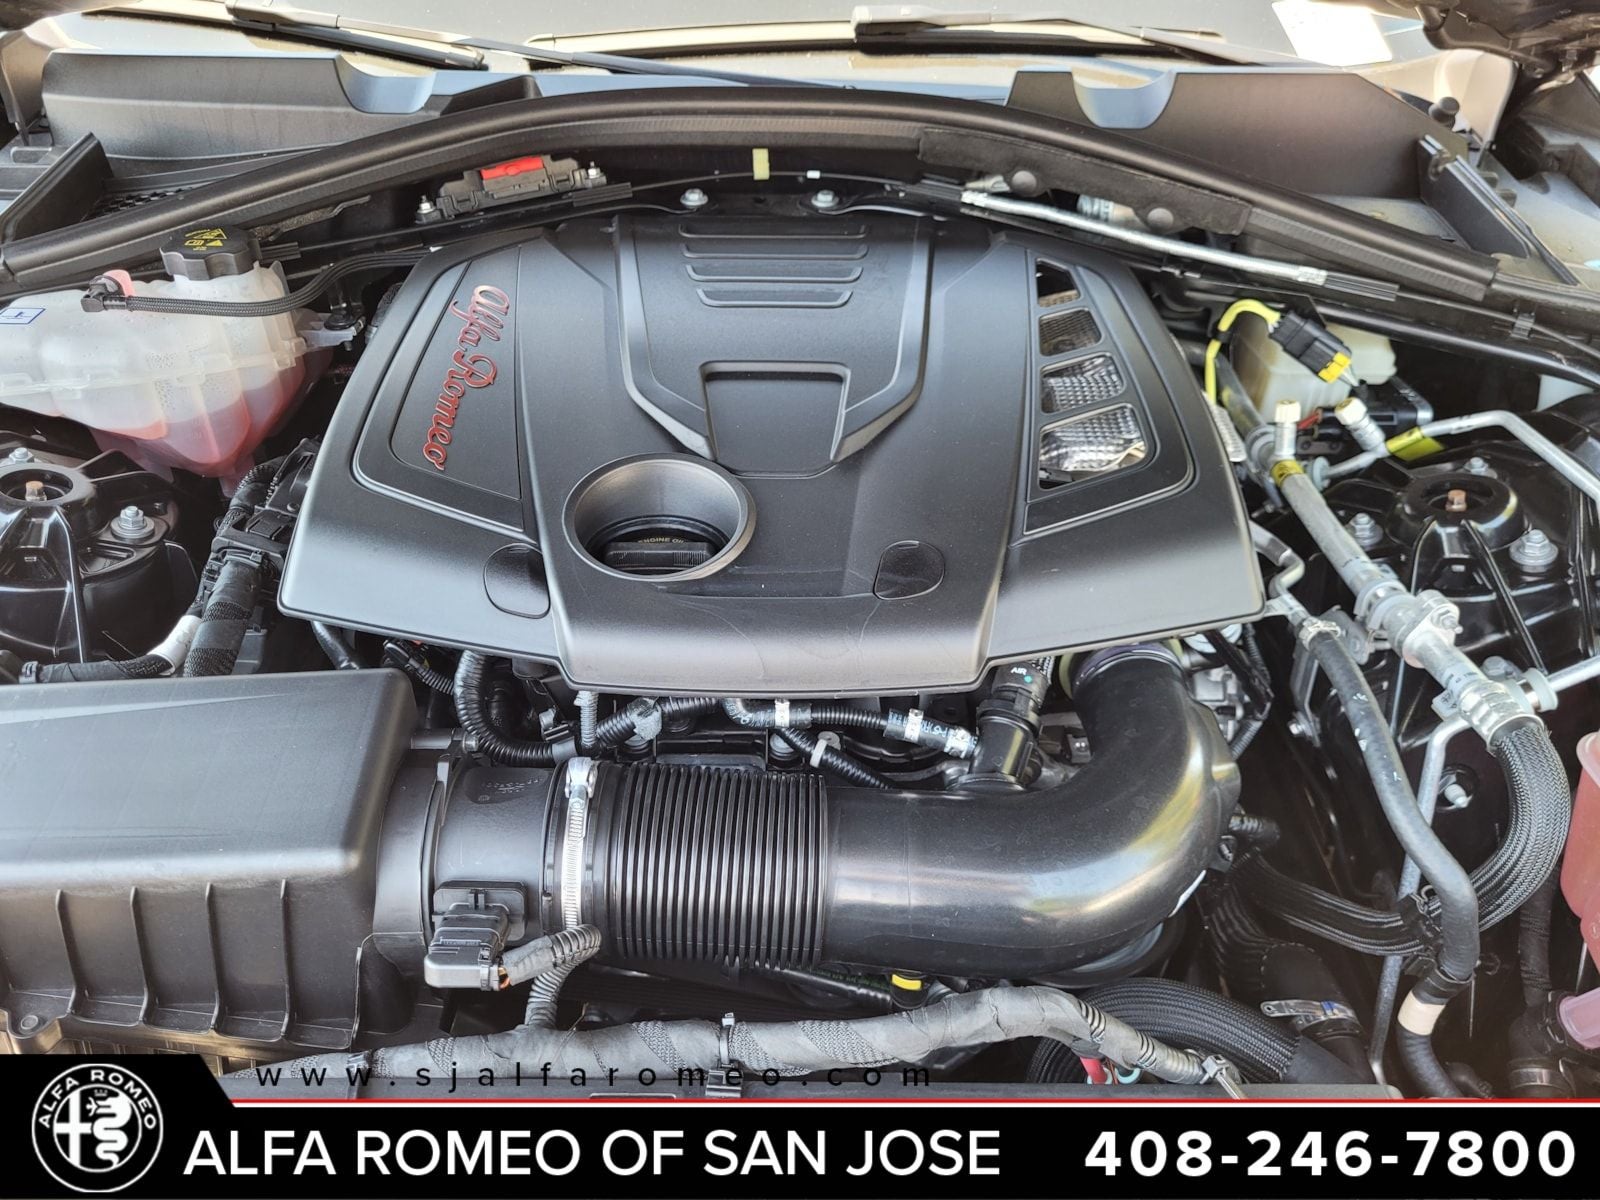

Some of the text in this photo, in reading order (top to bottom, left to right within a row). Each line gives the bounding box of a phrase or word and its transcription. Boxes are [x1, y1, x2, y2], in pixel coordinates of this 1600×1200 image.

[422, 284, 510, 472] Alfa Romeo
[1010, 666, 1028, 676] AIR
